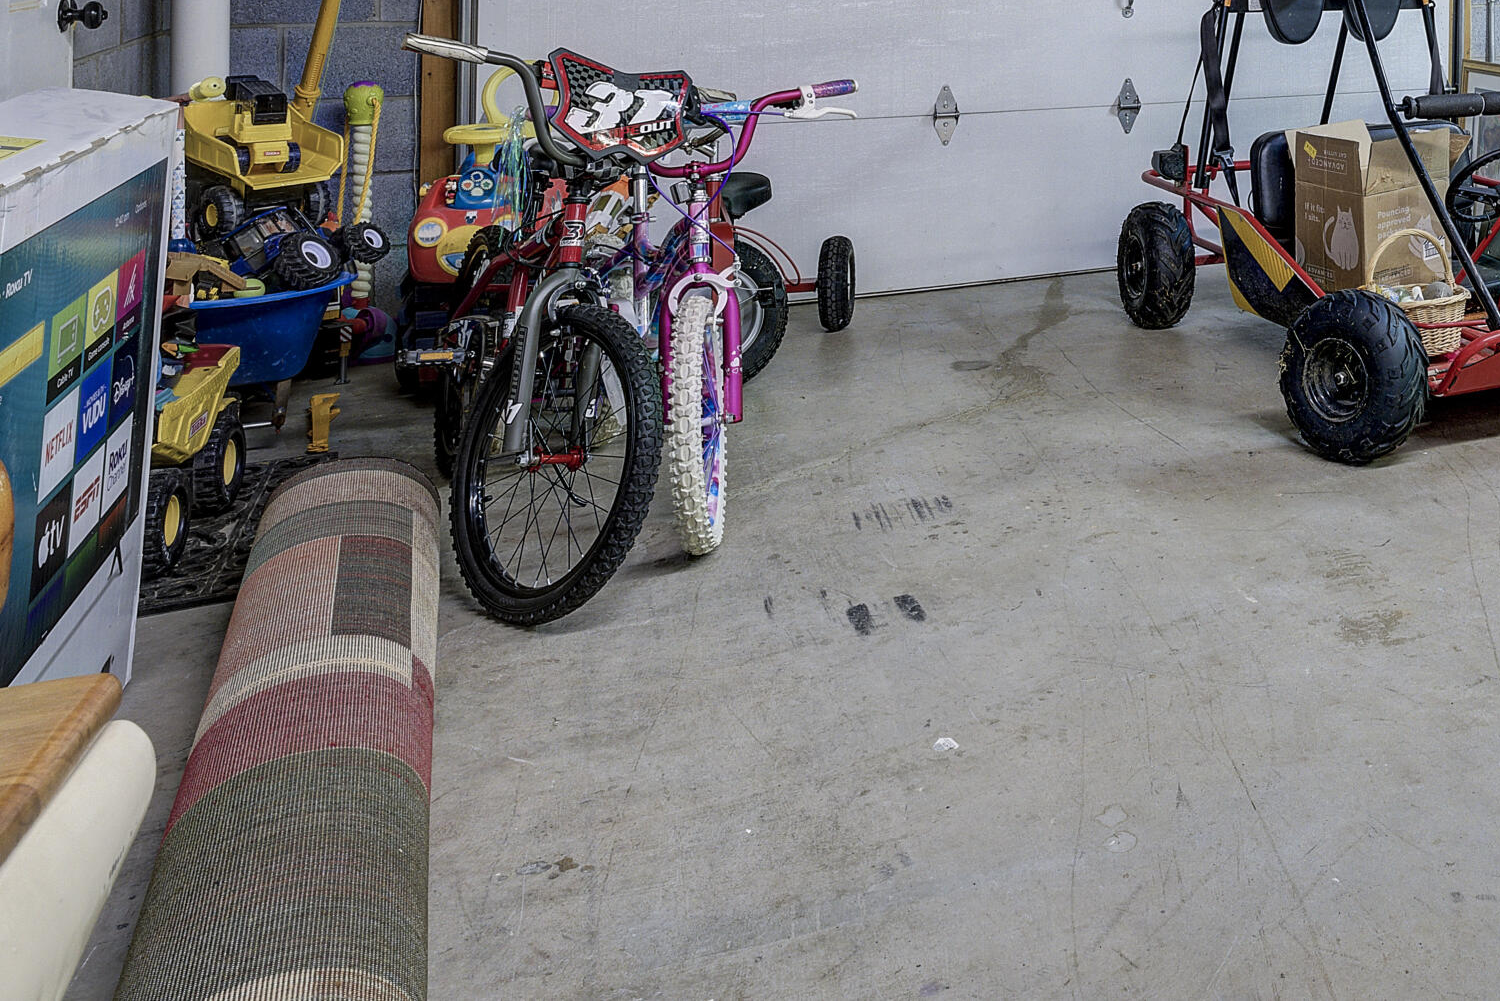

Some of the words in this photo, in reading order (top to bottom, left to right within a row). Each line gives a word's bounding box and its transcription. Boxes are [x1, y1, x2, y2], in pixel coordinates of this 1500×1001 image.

[1377, 206, 1411, 219] Pouncing
[1377, 214, 1411, 230] approved
[23, 268, 34, 288] TV
[82, 392, 107, 435] VUDU
[44, 418, 74, 468] NETFLIX
